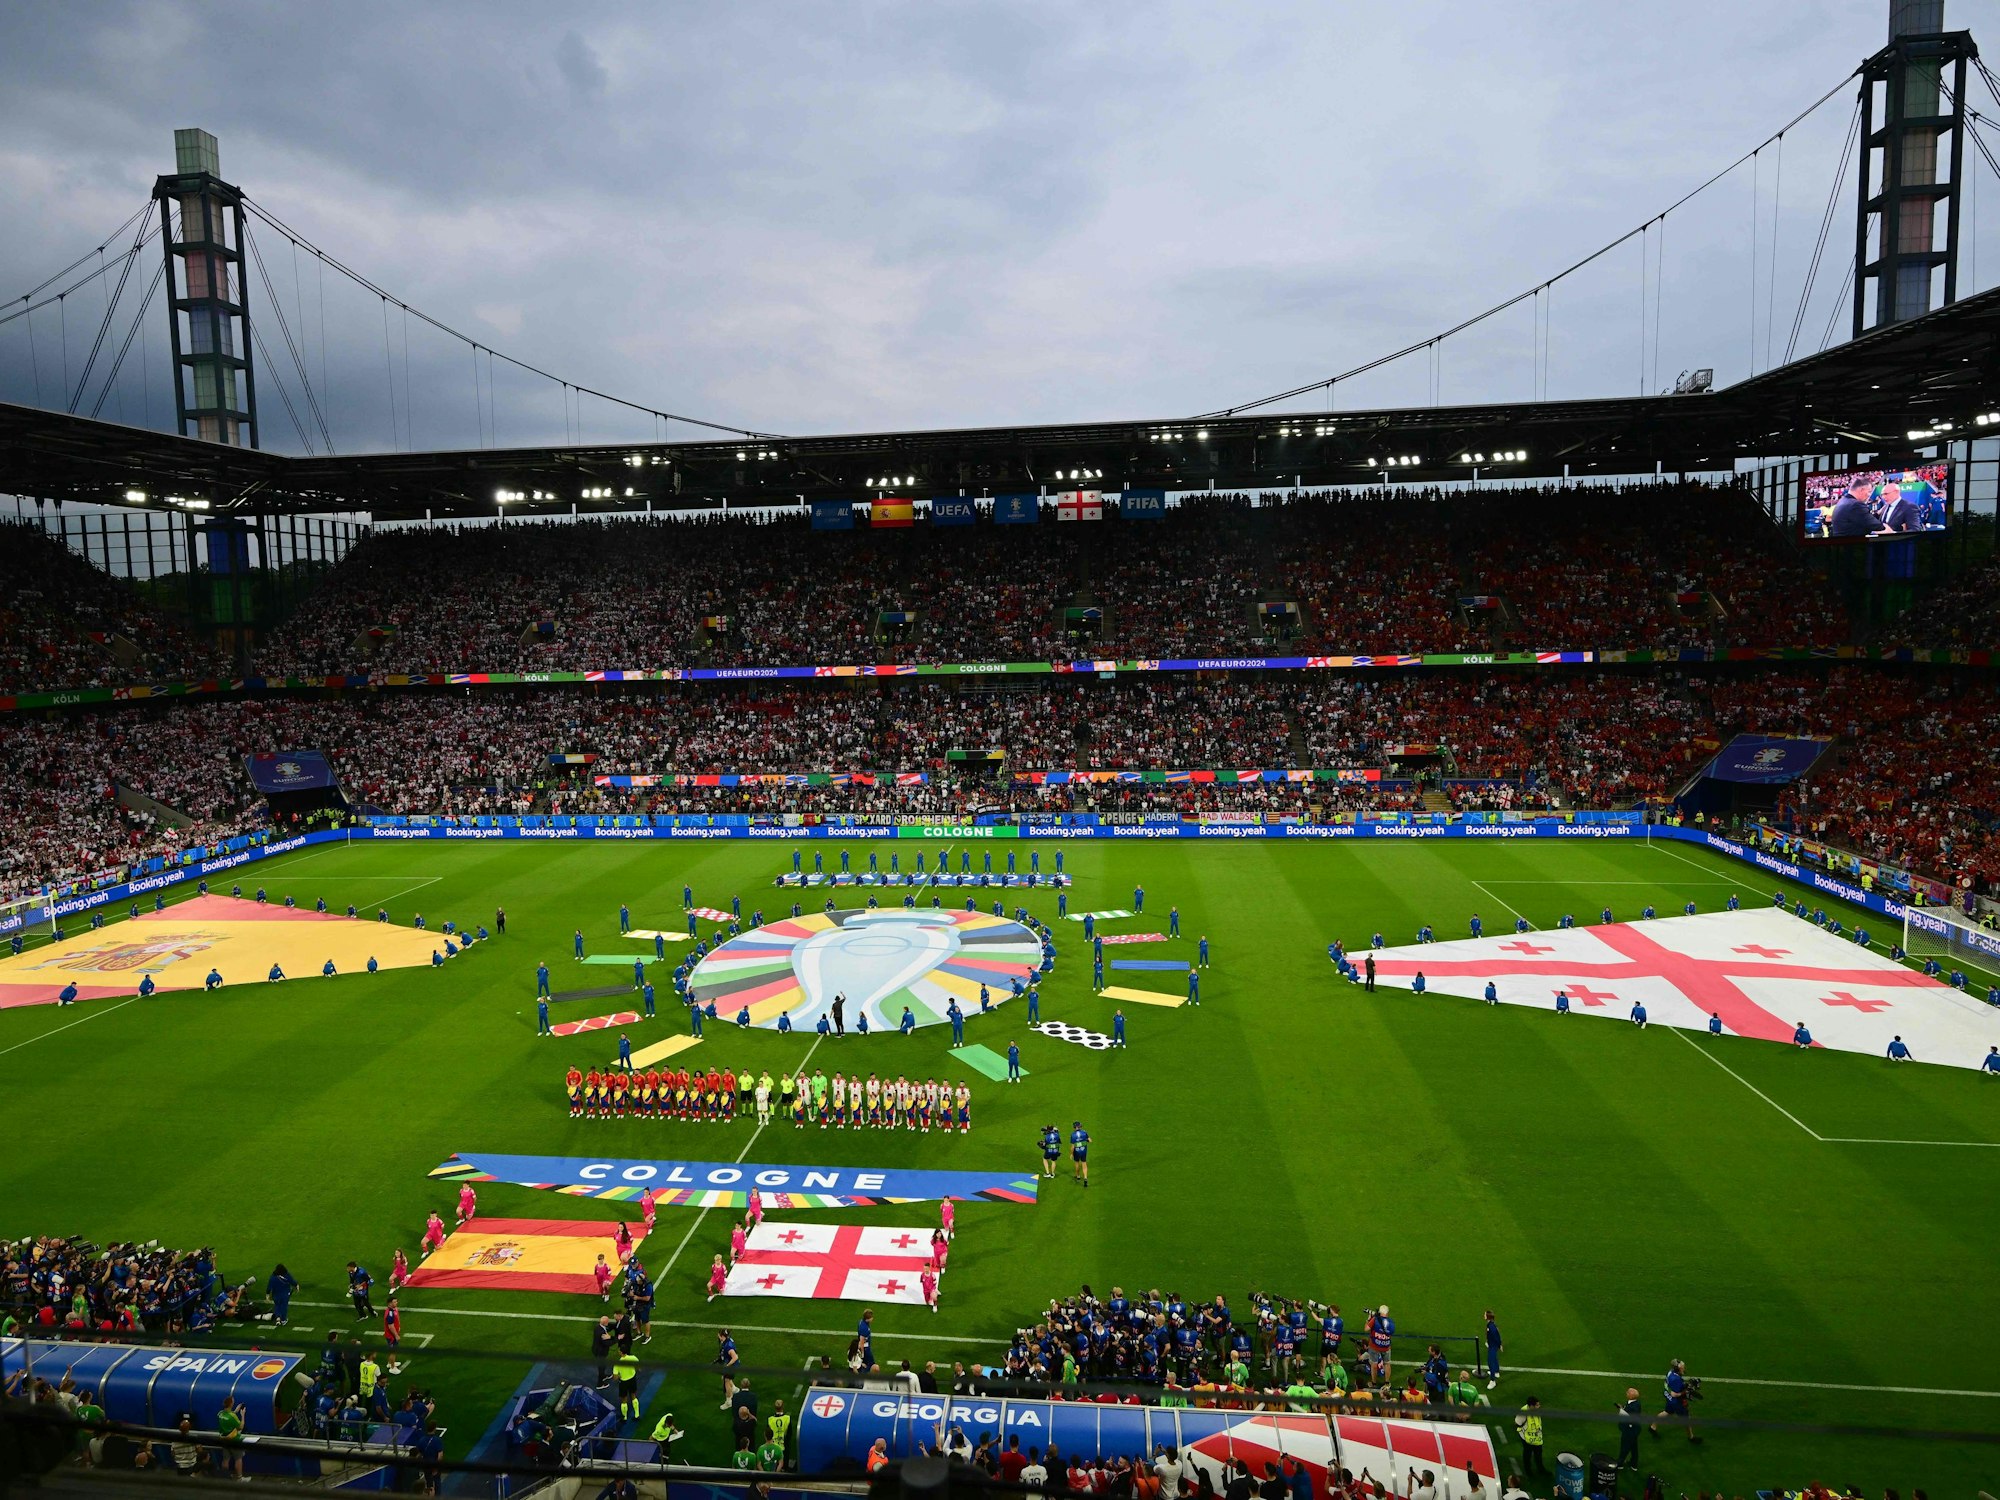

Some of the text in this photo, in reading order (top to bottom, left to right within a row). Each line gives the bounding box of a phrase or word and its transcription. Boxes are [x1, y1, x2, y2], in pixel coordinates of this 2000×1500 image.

[935, 503, 970, 516] UEFA
[1127, 497, 1159, 510] FIFA
[1463, 654, 1492, 665] KÖLN
[960, 664, 1007, 673] COLOGNE
[525, 672, 549, 682] KÖLN
[53, 692, 80, 704] KÖLN
[1145, 813, 1178, 822] HADERN
[373, 827, 430, 838] Booking.yeah
[446, 827, 503, 838] Booking.yeah
[519, 827, 578, 838] Booking.yeah
[595, 827, 654, 838] Booking.yeah
[671, 827, 731, 838] Booking.yeah
[748, 826, 810, 838] Booking.yeah
[827, 826, 890, 838] Booking.yeah
[923, 826, 993, 837] COLOGNE
[1029, 826, 1094, 837] Booking.yeah
[1113, 826, 1179, 837] Booking.yeah
[1199, 826, 1266, 837] Booking.yeah
[1286, 825, 1354, 837] Booking.yeah
[1375, 824, 1445, 837] Booking.yeah
[1466, 824, 1536, 837] Booking.yeah
[1557, 824, 1630, 837] Booking.yeah
[264, 835, 306, 855] Booking.yeah
[1707, 832, 1743, 857] Booking.yeah
[202, 851, 250, 873] Booking.yeah
[1756, 852, 1799, 877] Booking.yeah
[129, 870, 185, 893] Booking.yeah
[1814, 874, 1866, 903] Booking.yeah
[43, 890, 109, 918] Booking.yeah
[1884, 900, 1947, 935] Bookng.yeah
[578, 1162, 887, 1191] COLOGNE
[143, 1356, 248, 1375] SPAIN
[872, 1401, 1042, 1427] GEORGIA
